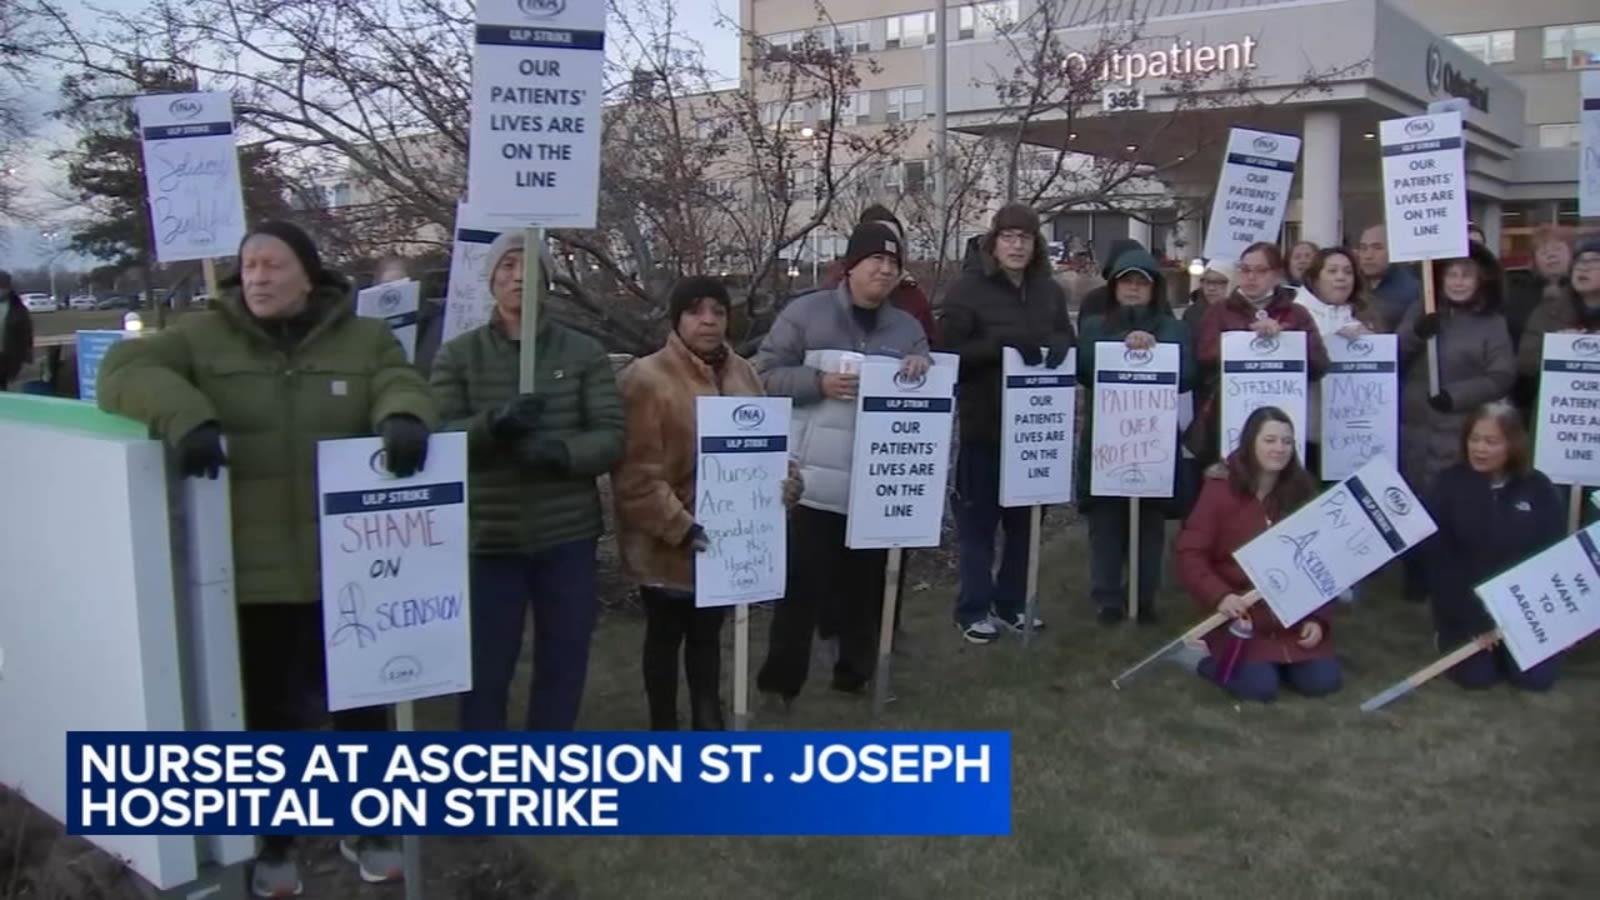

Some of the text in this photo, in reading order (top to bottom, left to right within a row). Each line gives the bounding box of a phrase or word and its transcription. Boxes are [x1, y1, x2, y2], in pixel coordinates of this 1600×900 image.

[532, 30, 573, 43] STRIKE
[518, 59, 560, 77] OUR
[490, 86, 587, 106] PATIENTS'
[490, 114, 585, 134] LIVES ARE
[501, 143, 572, 161] ON THE
[1409, 159, 1435, 171] OUR
[515, 170, 557, 188] LINE
[1246, 172, 1269, 183] OUR
[1394, 173, 1454, 189] PATIENTS'
[1229, 185, 1280, 201] PATIENTS'
[1395, 190, 1455, 205] LIVES ARE
[1226, 200, 1275, 216] LIVES ARE
[1403, 207, 1448, 221] ON THE
[1228, 216, 1265, 230] ON THE
[1413, 224, 1439, 236] LINE
[1232, 231, 1254, 243] LINE
[1029, 395, 1053, 407] OUR
[1102, 388, 1178, 414] PATIENTS
[1014, 412, 1067, 426] PATIENTS'
[1550, 414, 1586, 426] LIVES
[891, 421, 921, 435] OUR
[1119, 416, 1161, 438] OVER
[1014, 430, 1065, 444] LIVES ARE
[1557, 431, 1578, 442] ON
[870, 442, 938, 456] PATIENTS'
[1020, 448, 1058, 461] ON THE
[1093, 438, 1168, 472] PROFITS
[1565, 448, 1594, 461] LINE
[868, 463, 935, 476] LIVES ARE
[1027, 466, 1051, 479] LINE
[361, 489, 430, 506] ULP STRIKE
[876, 484, 926, 497] ON THE
[699, 489, 736, 516] Are
[884, 504, 914, 518] LINE
[340, 508, 445, 553] SHAME
[1320, 490, 1374, 557] PAY UP
[369, 556, 401, 579] ON
[1573, 573, 1591, 595] WE
[1551, 572, 1580, 614] WANT
[1539, 593, 1555, 614] TO
[331, 582, 463, 649] ASCENSION
[1509, 584, 1548, 644] BARGAIN
